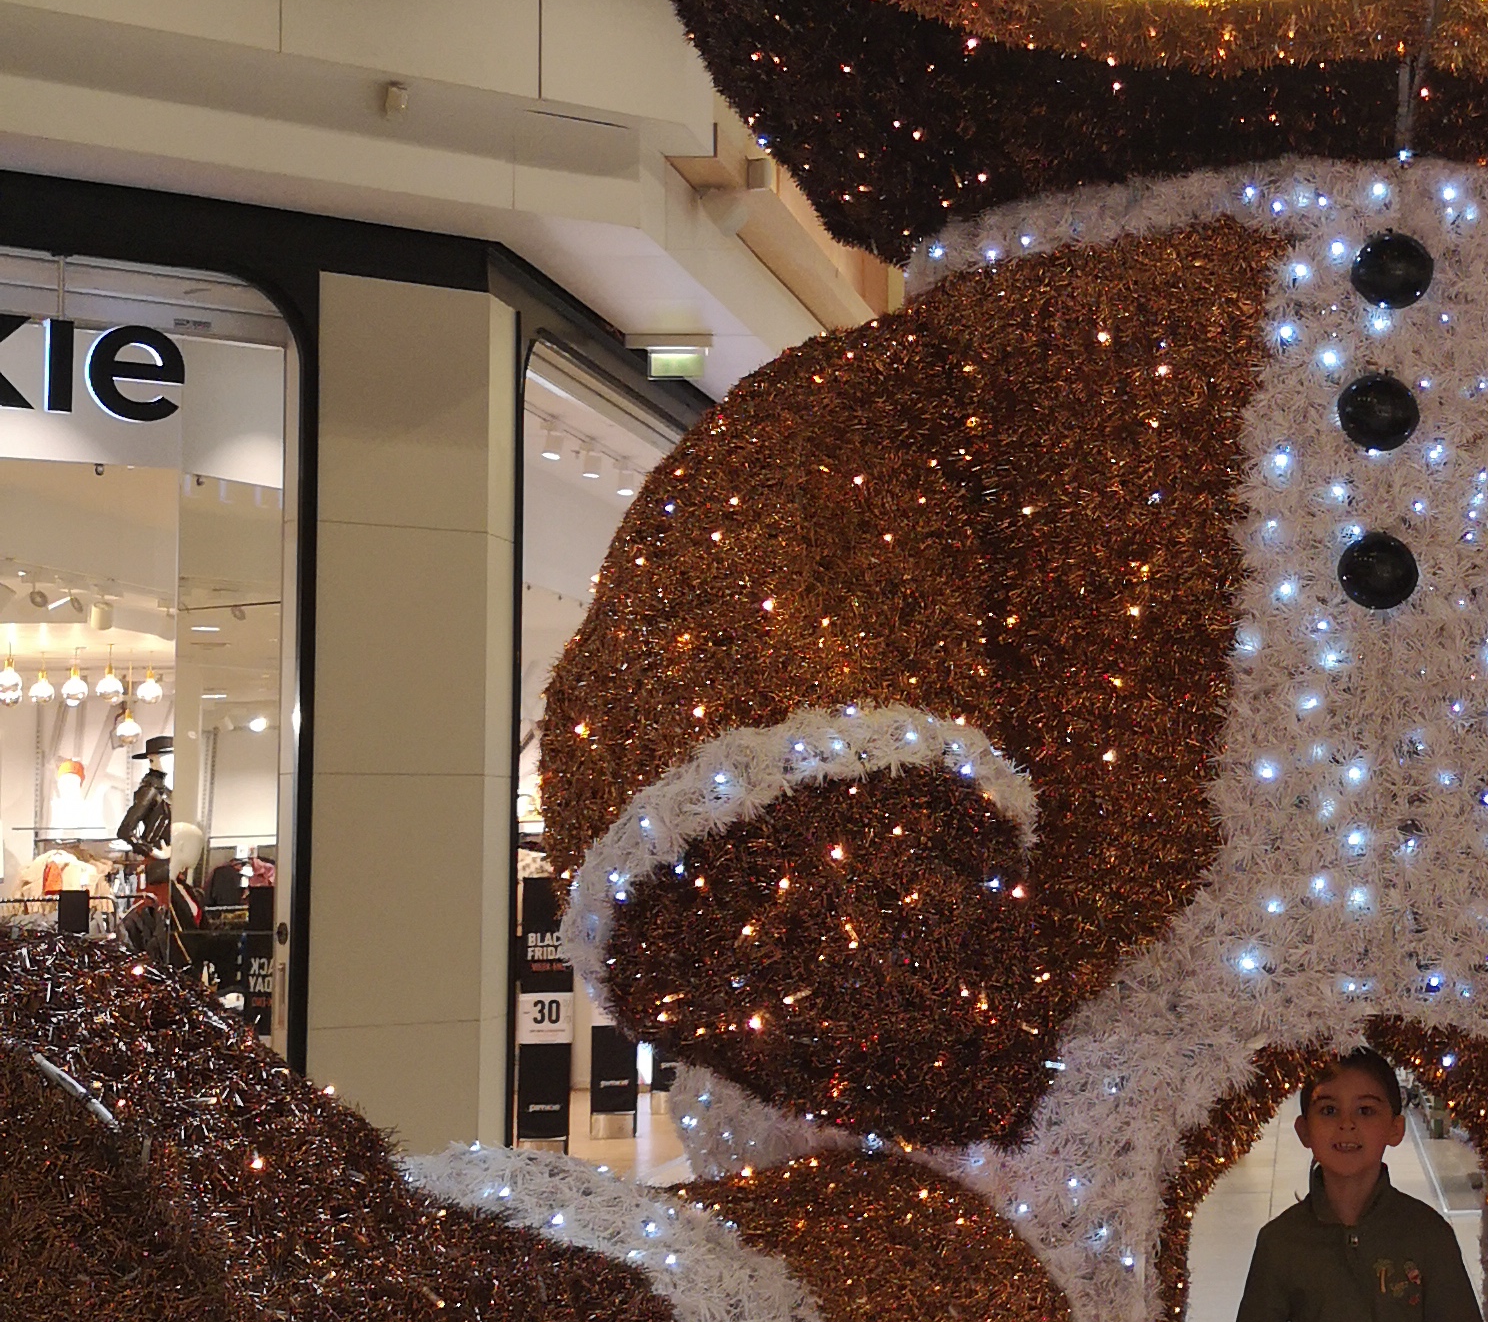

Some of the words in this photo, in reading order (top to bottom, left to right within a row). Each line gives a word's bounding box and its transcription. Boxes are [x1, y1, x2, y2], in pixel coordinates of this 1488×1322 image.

[527, 932, 562, 946] BLAC
[527, 946, 565, 960] FRIDA
[533, 999, 560, 1024] 30
